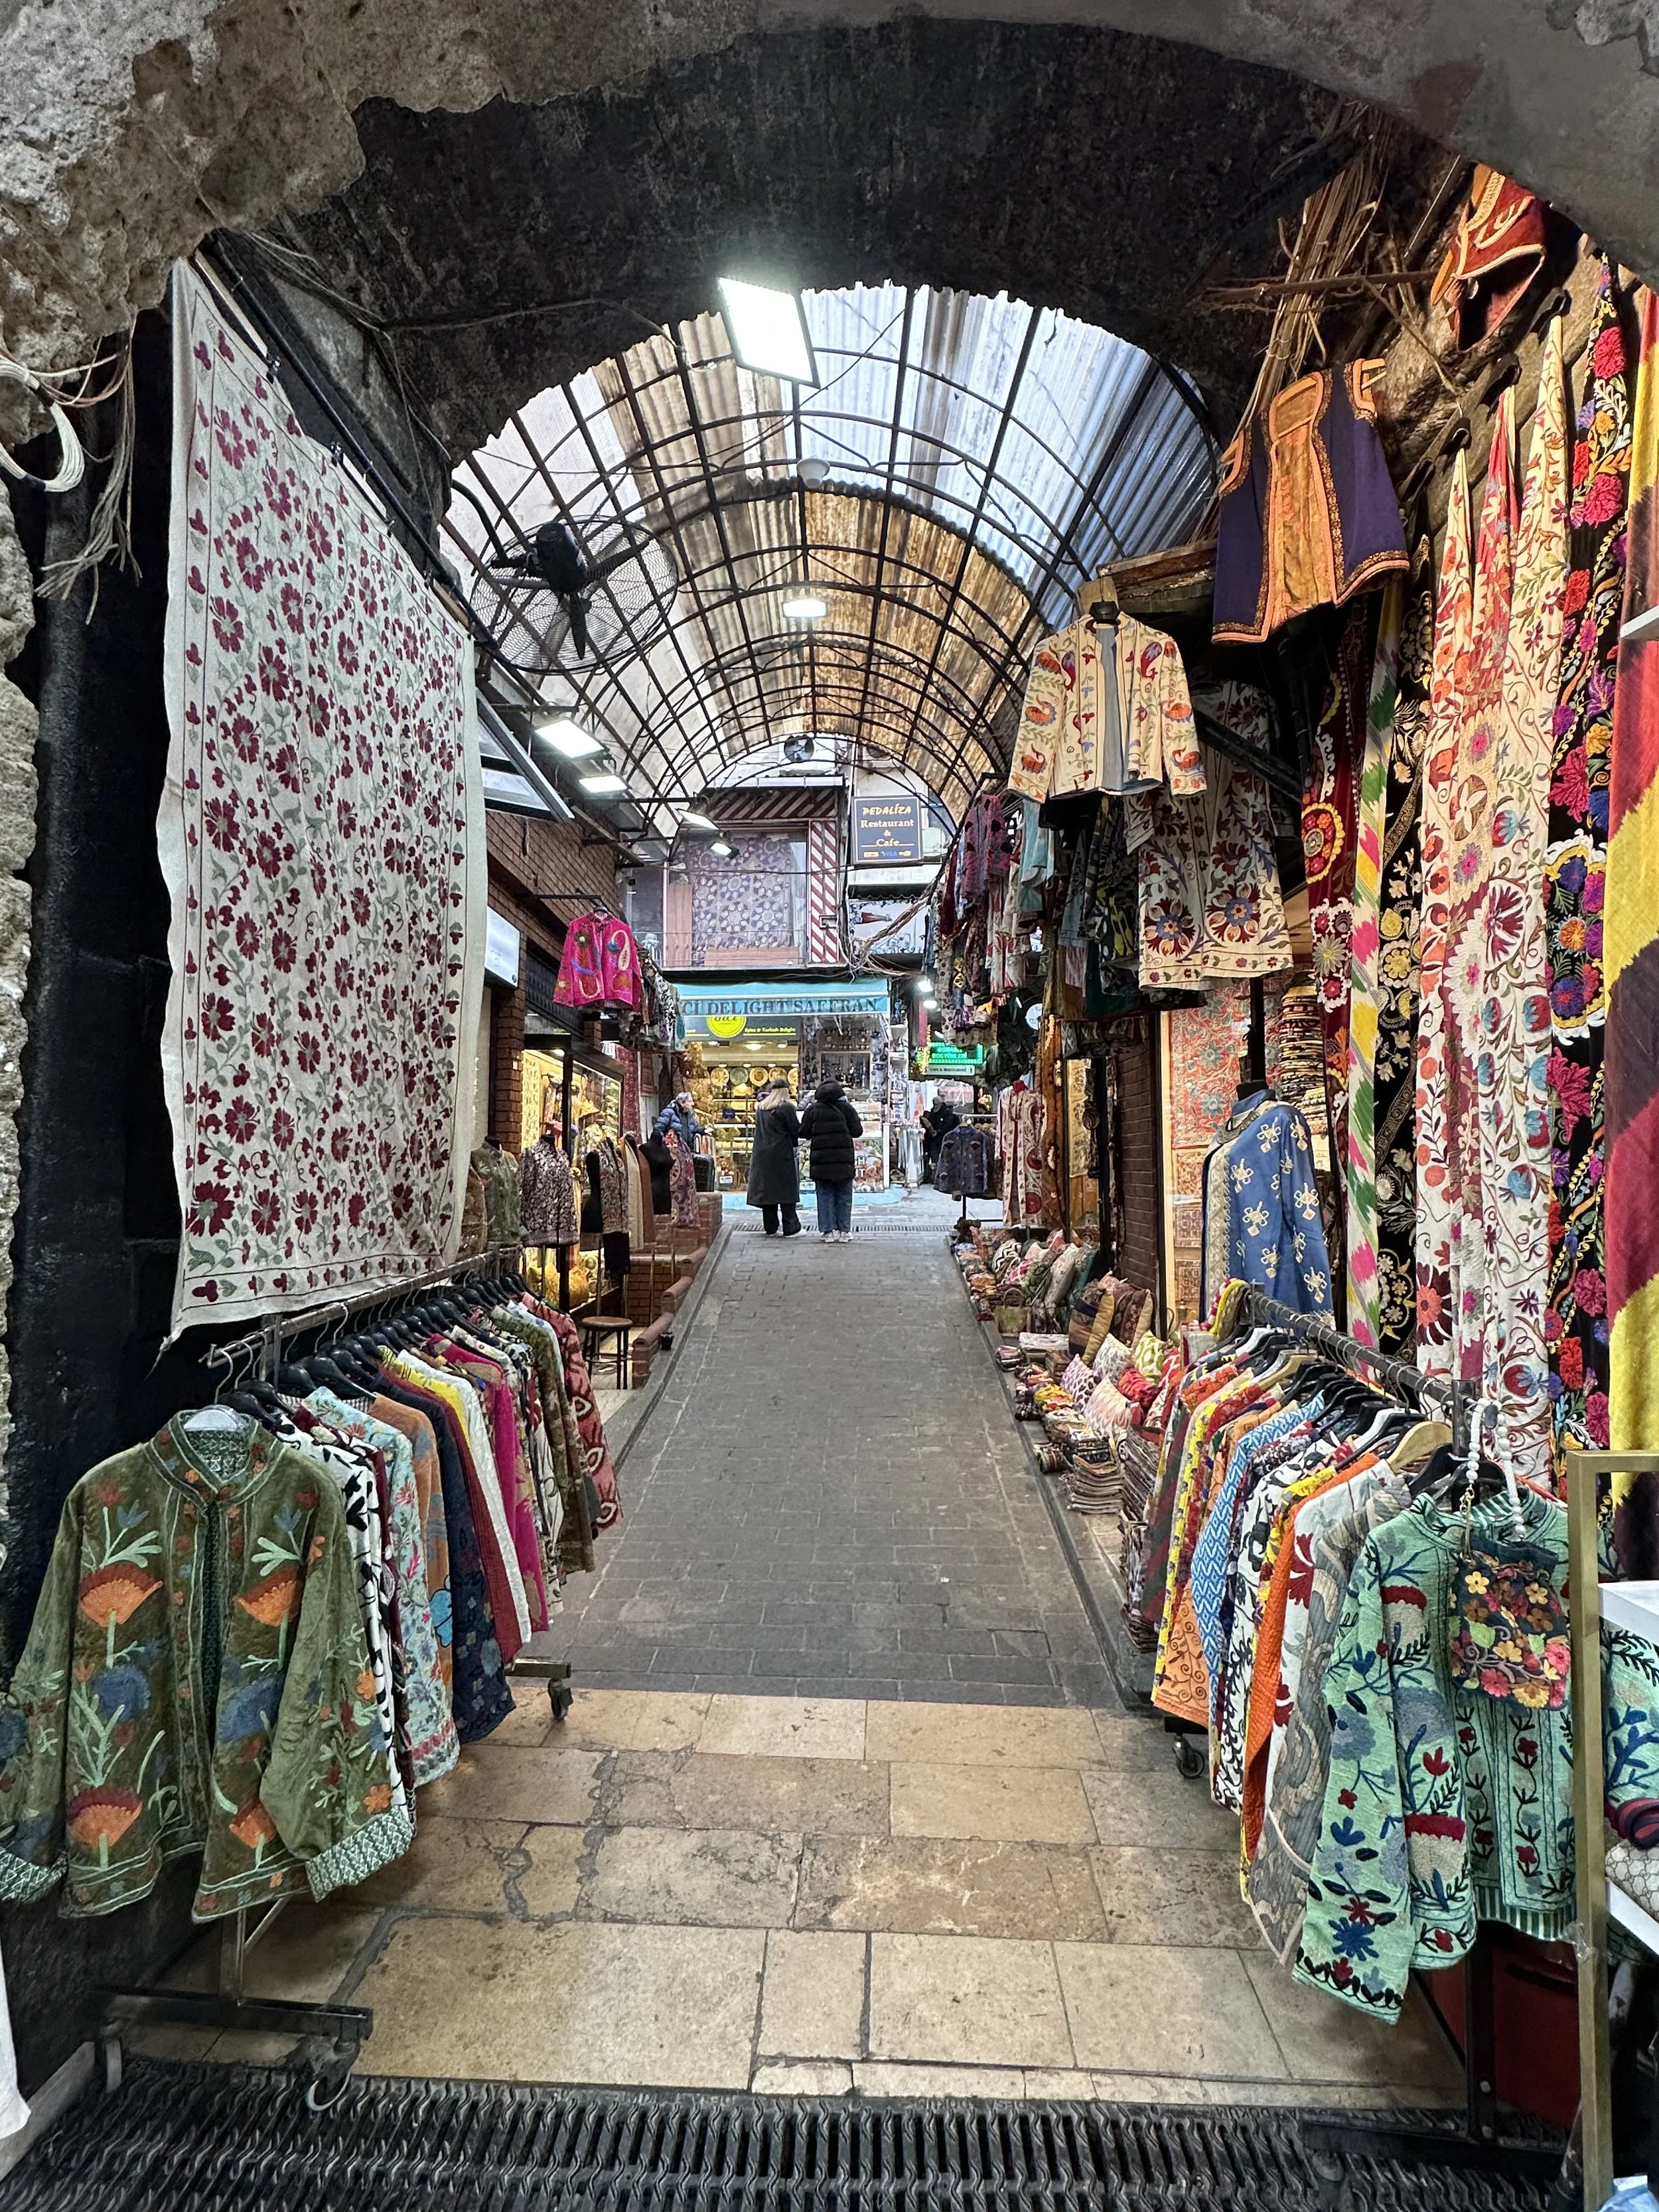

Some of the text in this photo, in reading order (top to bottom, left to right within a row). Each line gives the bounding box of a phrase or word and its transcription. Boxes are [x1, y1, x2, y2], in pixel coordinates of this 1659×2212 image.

[861, 819, 914, 828] Restaurant
[876, 838, 900, 847] Cafe
[707, 1000, 788, 1015] DELIGHT
[794, 998, 878, 1013] SAFFRAN
